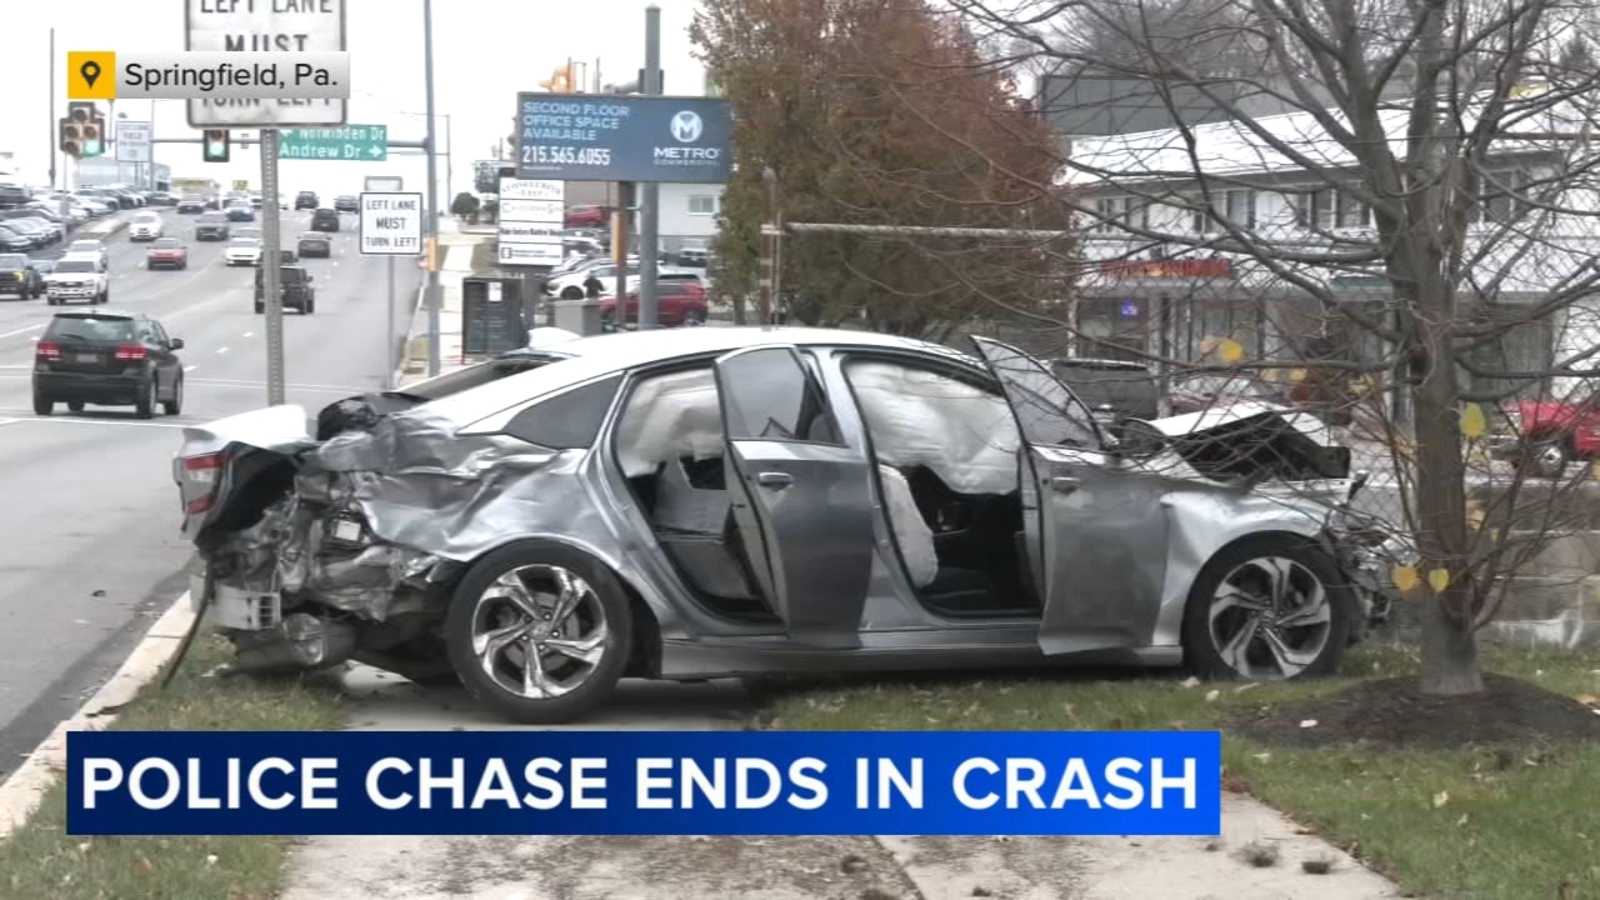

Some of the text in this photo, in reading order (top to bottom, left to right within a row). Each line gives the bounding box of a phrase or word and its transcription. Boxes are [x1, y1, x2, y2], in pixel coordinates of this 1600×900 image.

[224, 34, 308, 51] MUST
[523, 102, 630, 117] SECOND FLOOR
[523, 114, 620, 129] OFFICE SPACE
[370, 128, 385, 141] Dr
[523, 128, 597, 141] AVAILABLE
[280, 142, 361, 158] Andrew Dr
[521, 145, 611, 166] 215.565.6055
[654, 147, 719, 160] METRO
[365, 199, 417, 211] LEFT LANE
[375, 217, 407, 230] MUST
[365, 236, 417, 248] TURN LEFT
